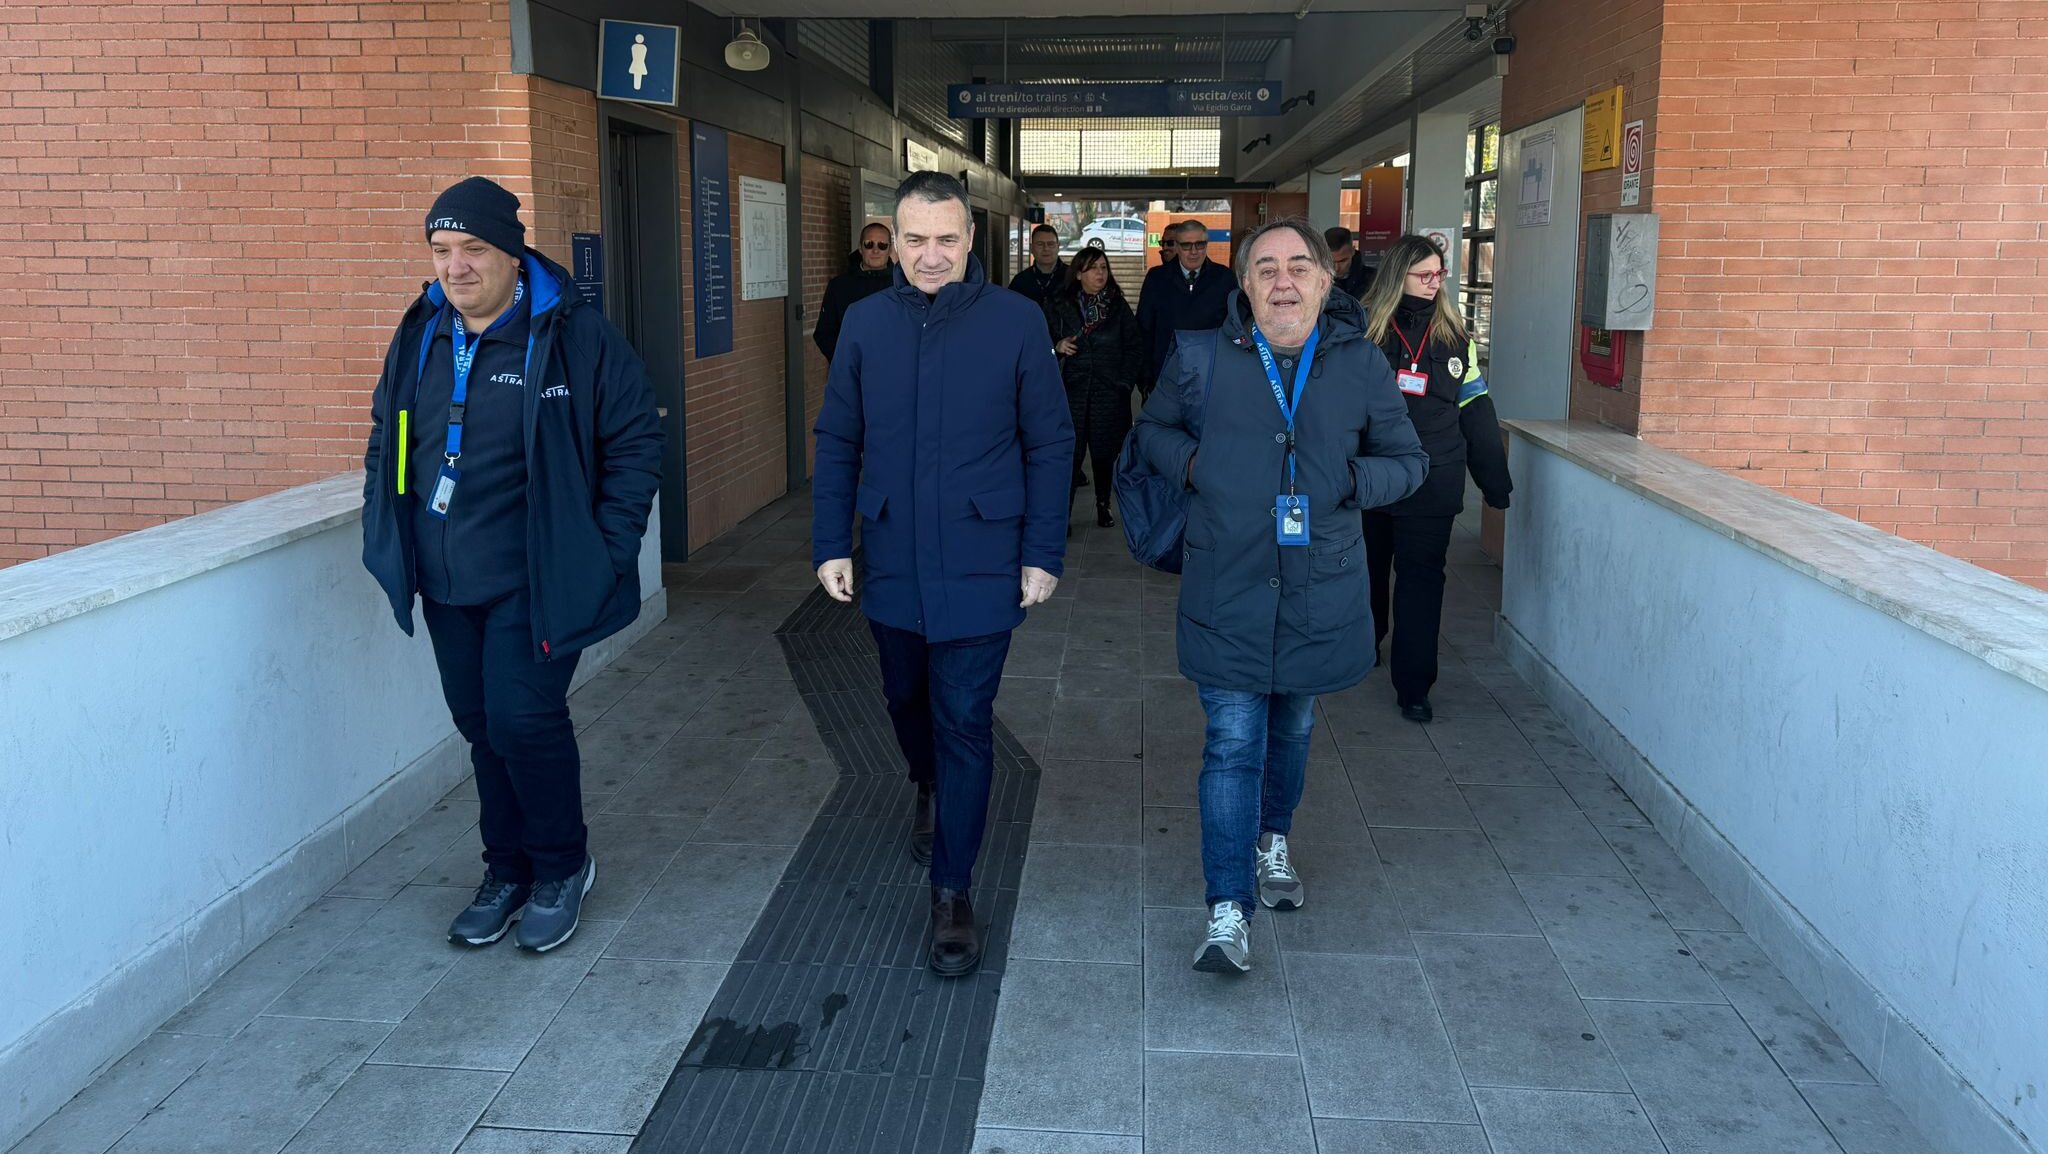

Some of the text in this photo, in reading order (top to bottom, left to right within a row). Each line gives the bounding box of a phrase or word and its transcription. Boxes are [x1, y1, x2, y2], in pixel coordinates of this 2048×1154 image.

[975, 92, 1068, 103] ai treni/to trains
[1191, 89, 1252, 101] uscita/exit
[997, 105, 1004, 113] le
[1006, 105, 1051, 113] direzioni/all
[1052, 105, 1084, 113] direction
[1192, 103, 1252, 113] Via Egidio Garra
[429, 217, 467, 229] ASTRAL
[1256, 342, 1273, 371] ASTRAL
[489, 373, 526, 387] ASTRA
[1270, 379, 1286, 409] ASTRAL
